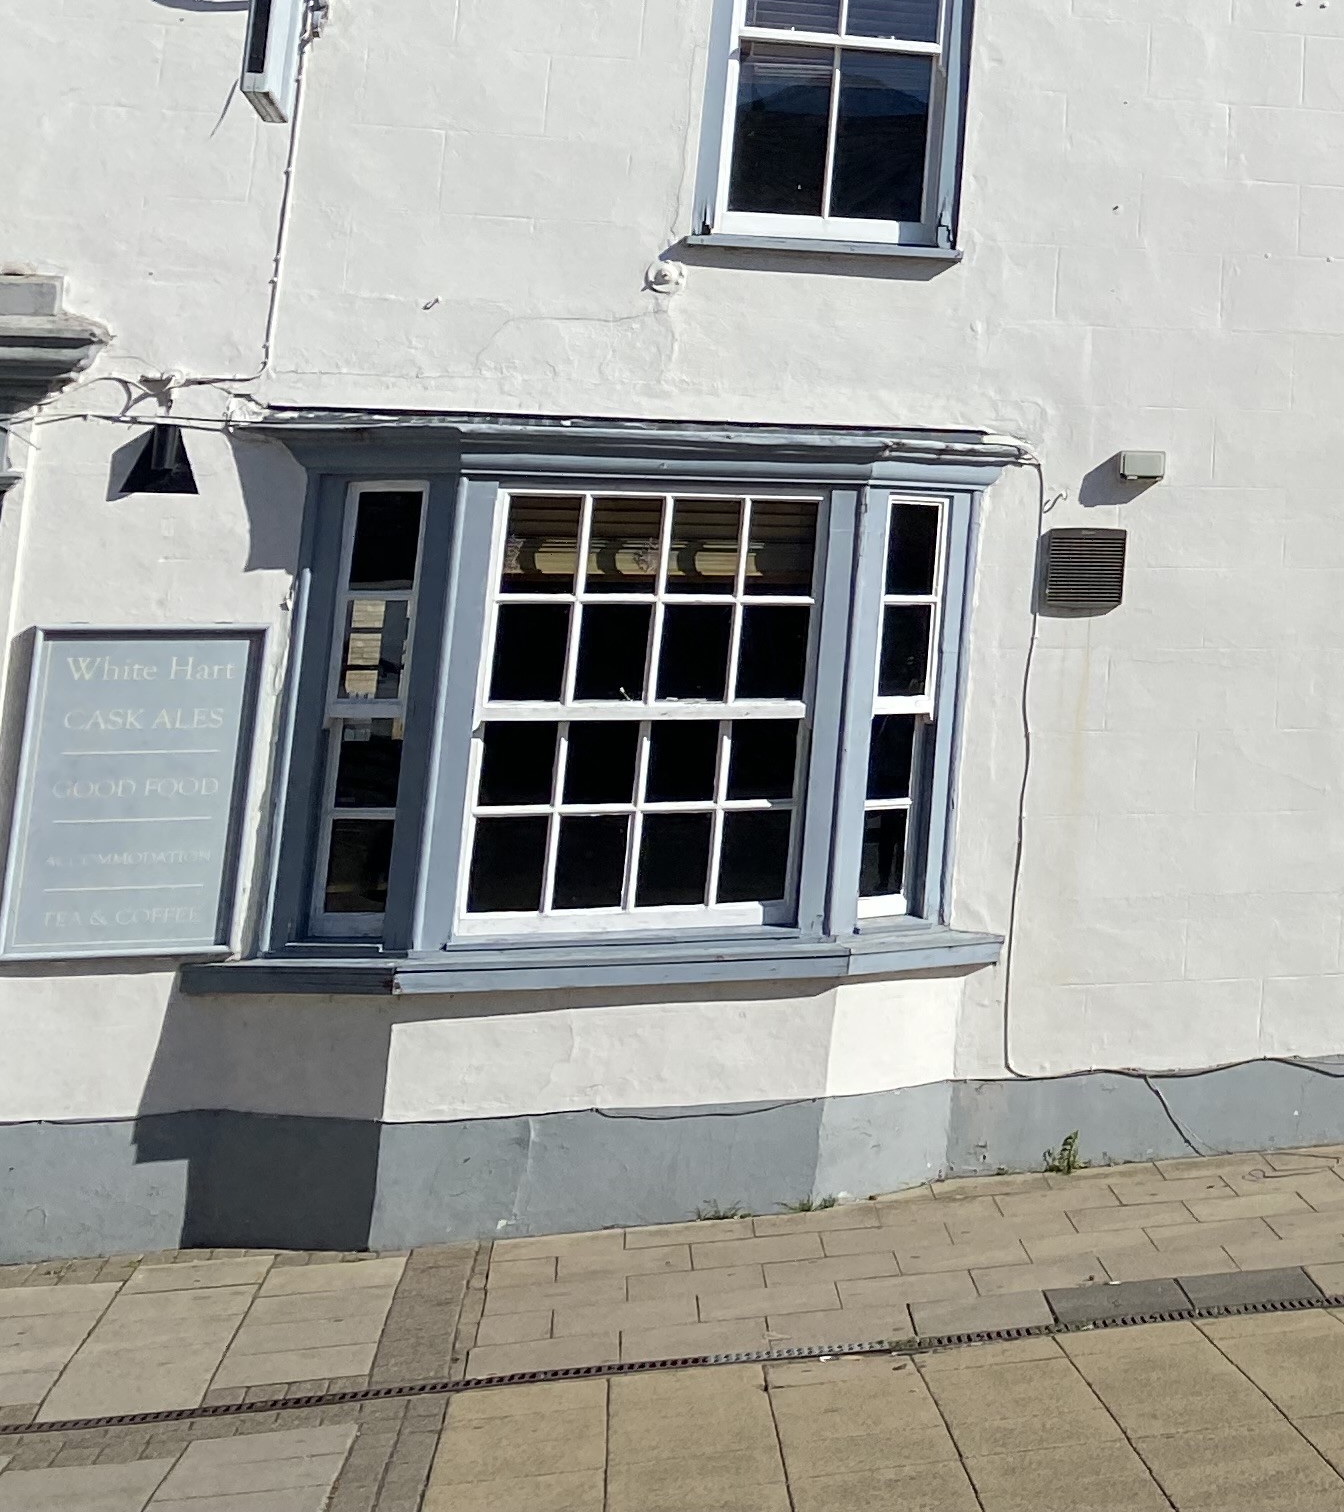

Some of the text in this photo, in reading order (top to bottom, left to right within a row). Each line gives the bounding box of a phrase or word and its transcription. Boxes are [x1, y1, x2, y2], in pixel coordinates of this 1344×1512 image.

[67, 655, 236, 682] White Hart
[64, 708, 225, 730] CASK ALES
[52, 777, 219, 798] GOOD FOOD
[45, 849, 212, 867] AMMODATION
[44, 907, 201, 928] TEA & COFFEE
